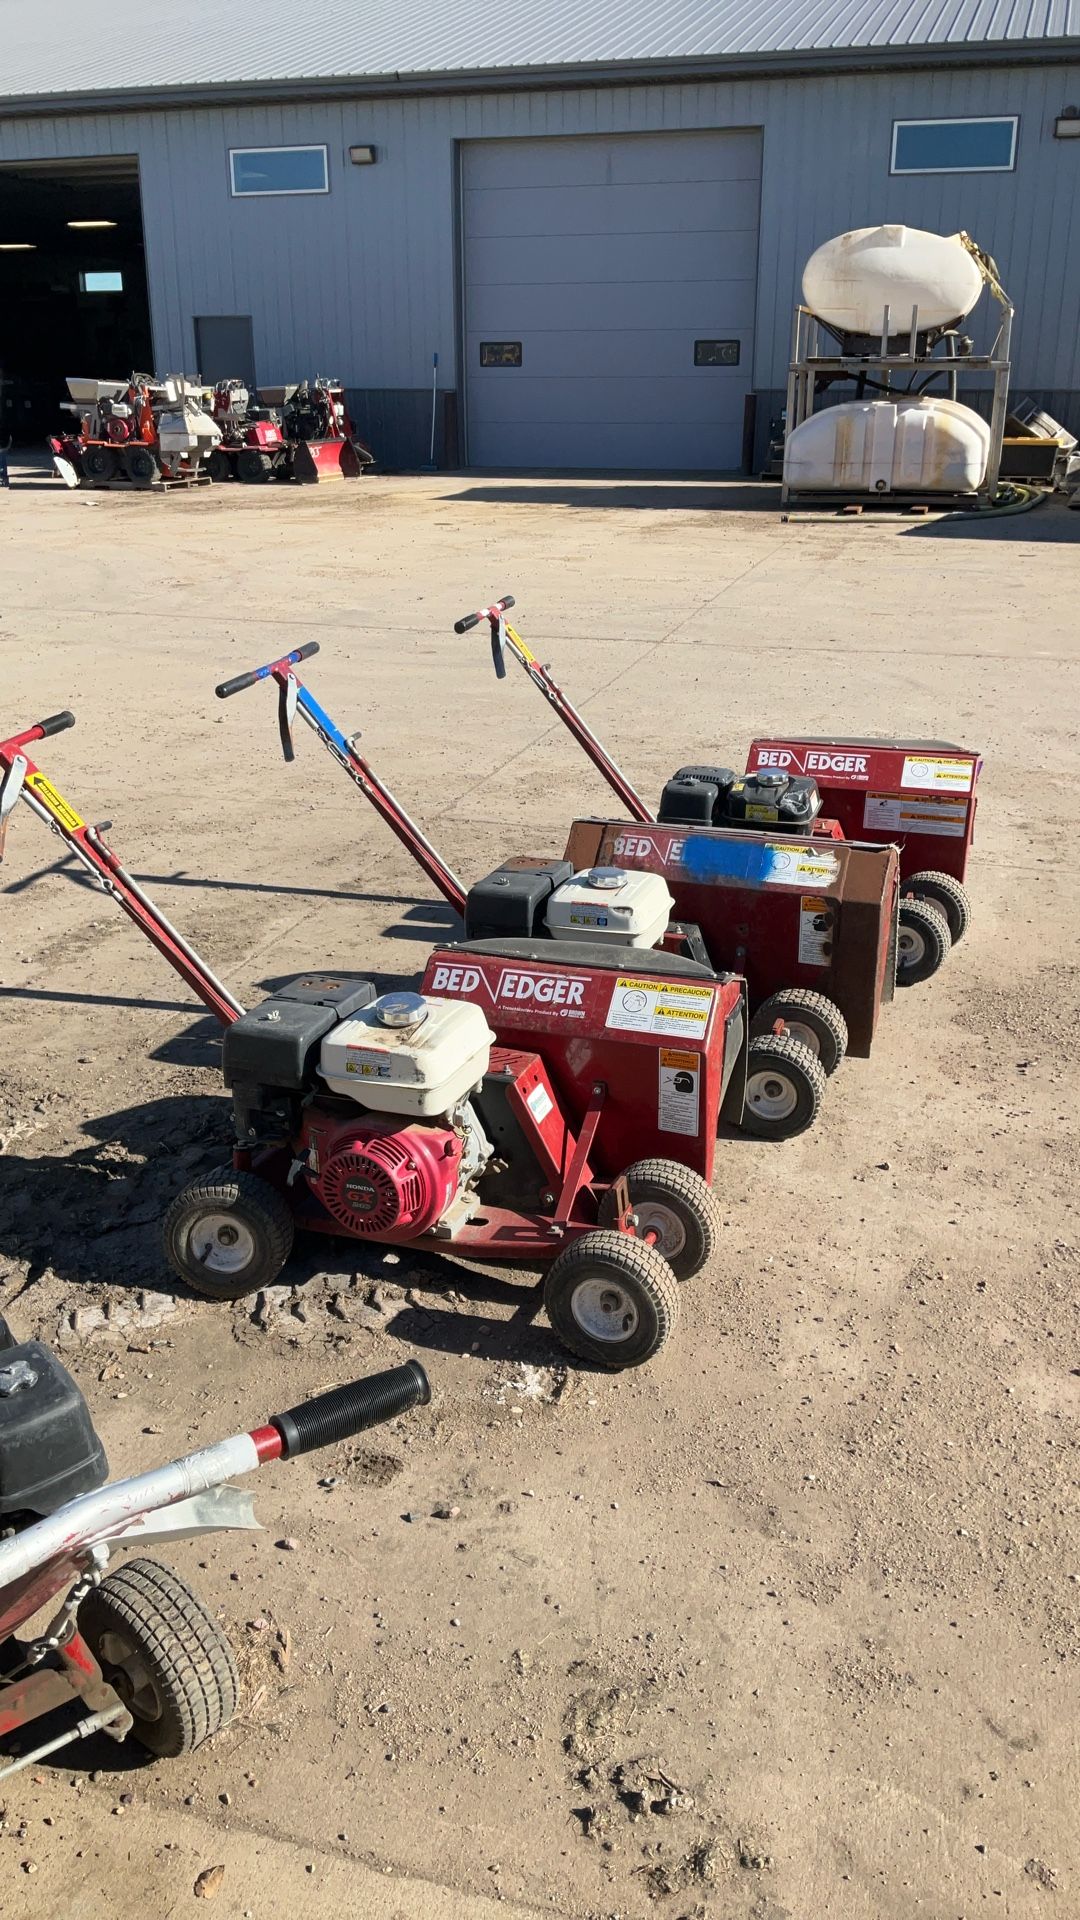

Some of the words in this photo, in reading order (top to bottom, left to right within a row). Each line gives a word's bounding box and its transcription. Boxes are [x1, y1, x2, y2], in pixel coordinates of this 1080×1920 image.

[757, 751, 792, 767] BED
[807, 754, 867, 773] EDGER
[613, 837, 652, 857] BED
[431, 967, 480, 993] BED
[501, 974, 585, 1005] EDGER
[629, 981, 658, 990] CAUTION
[670, 986, 711, 997] PRECAUCIÓN
[666, 1009, 704, 1020] ATTENTION
[346, 1183, 375, 1192] HONDA
[347, 1191, 374, 1203] GX
